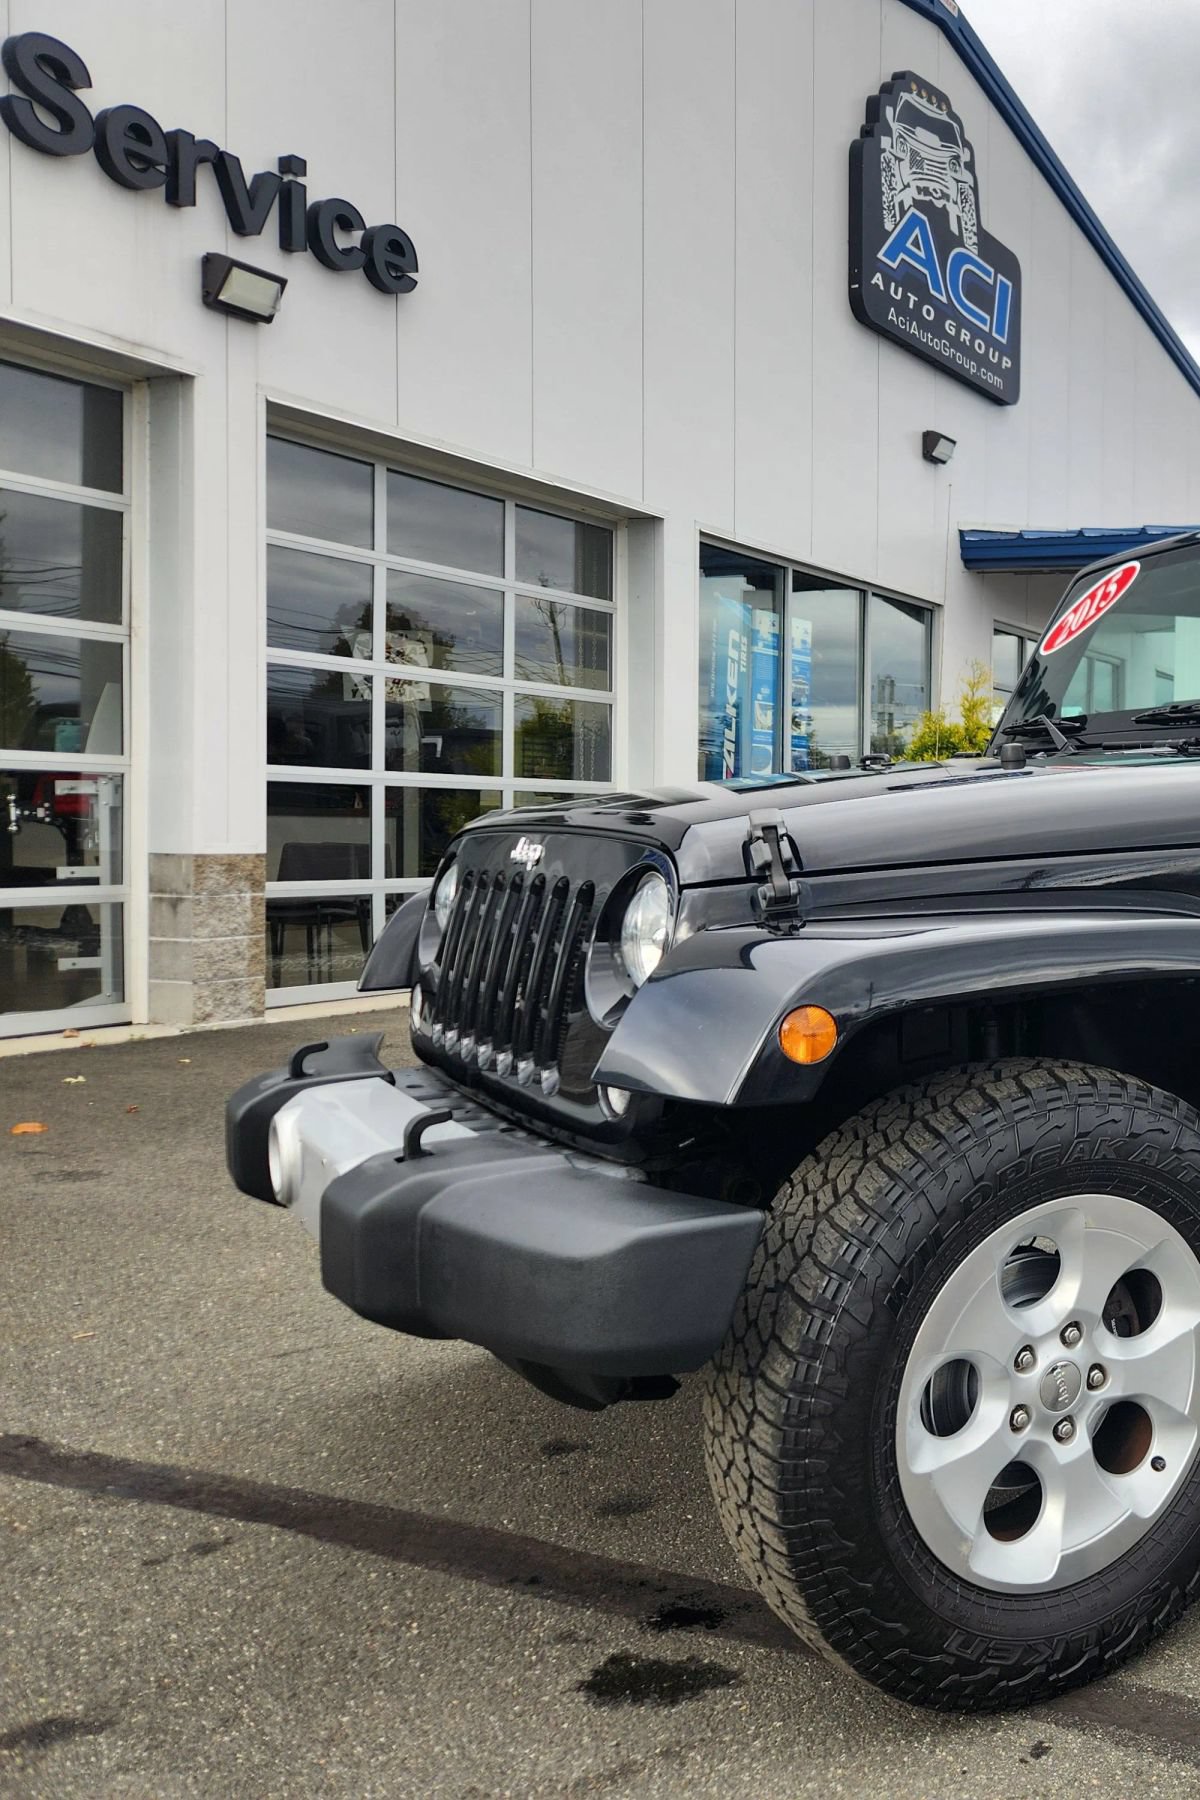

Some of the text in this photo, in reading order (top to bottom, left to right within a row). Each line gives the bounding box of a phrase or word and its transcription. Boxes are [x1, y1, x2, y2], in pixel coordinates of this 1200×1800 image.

[0, 31, 419, 294] Service
[871, 272, 1013, 371] AUTO GROUP
[877, 205, 1013, 346] ACI
[887, 307, 1004, 390] AciAutoGroup.com
[1053, 569, 1124, 648] 2015
